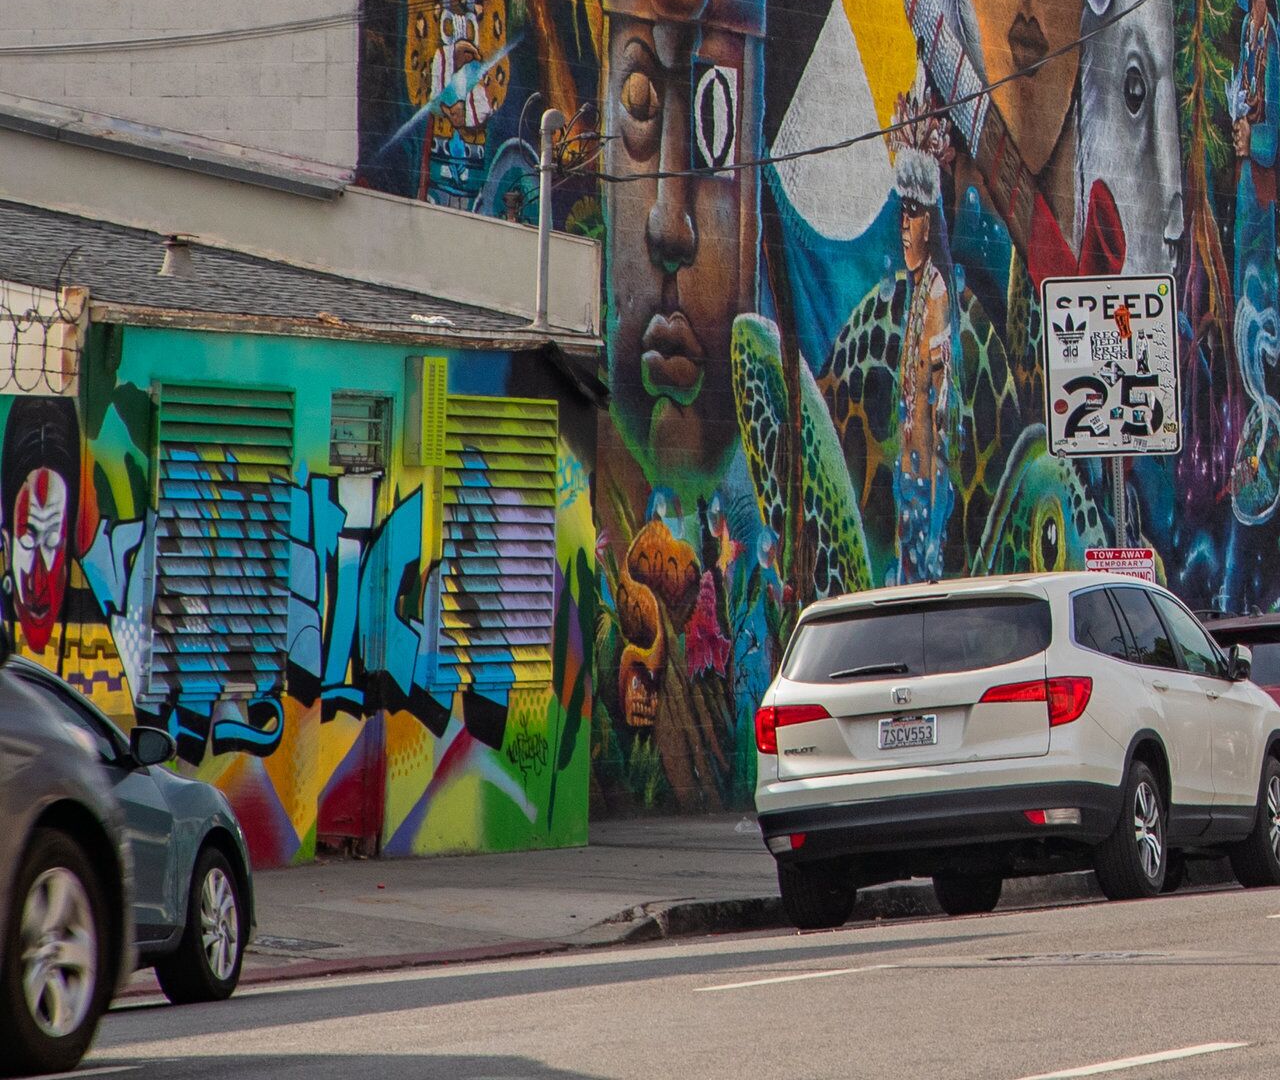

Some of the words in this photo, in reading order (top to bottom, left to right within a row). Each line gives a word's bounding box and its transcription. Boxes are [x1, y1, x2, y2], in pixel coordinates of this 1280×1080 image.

[1062, 374, 1164, 438] 25
[1093, 551, 1145, 559] TOW-AWAY
[883, 725, 933, 744] 7SCV553
[784, 746, 817, 756] PILOT
